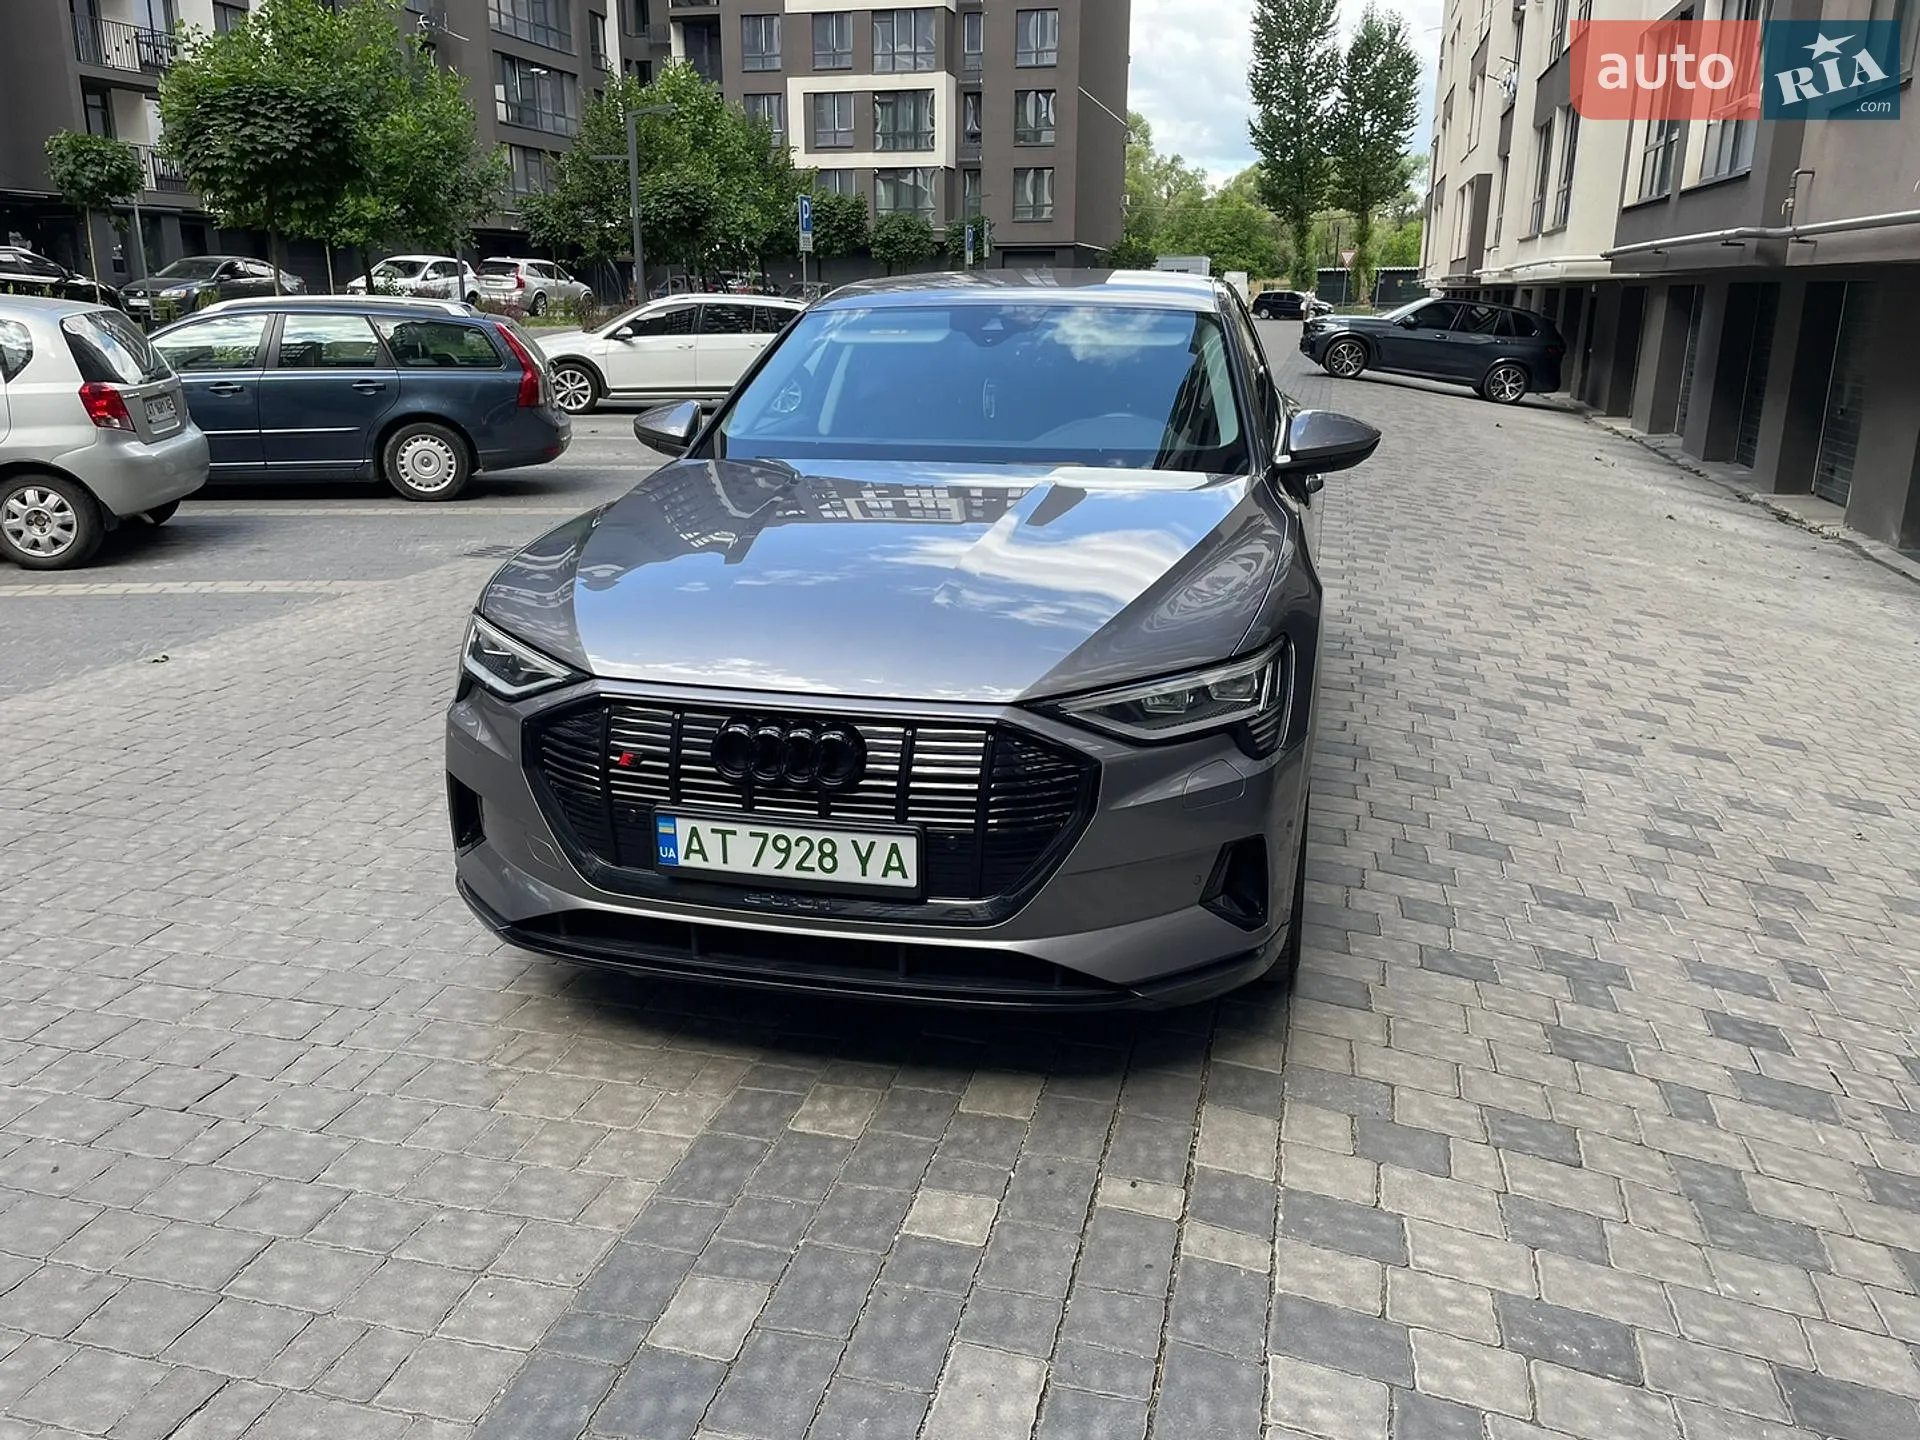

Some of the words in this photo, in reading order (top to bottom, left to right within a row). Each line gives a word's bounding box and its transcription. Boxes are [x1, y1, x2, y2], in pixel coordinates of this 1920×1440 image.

[802, 200, 810, 229] P
[660, 846, 676, 859] UA
[683, 826, 737, 865] AT
[749, 831, 839, 875] 7928
[851, 839, 909, 880] YA
